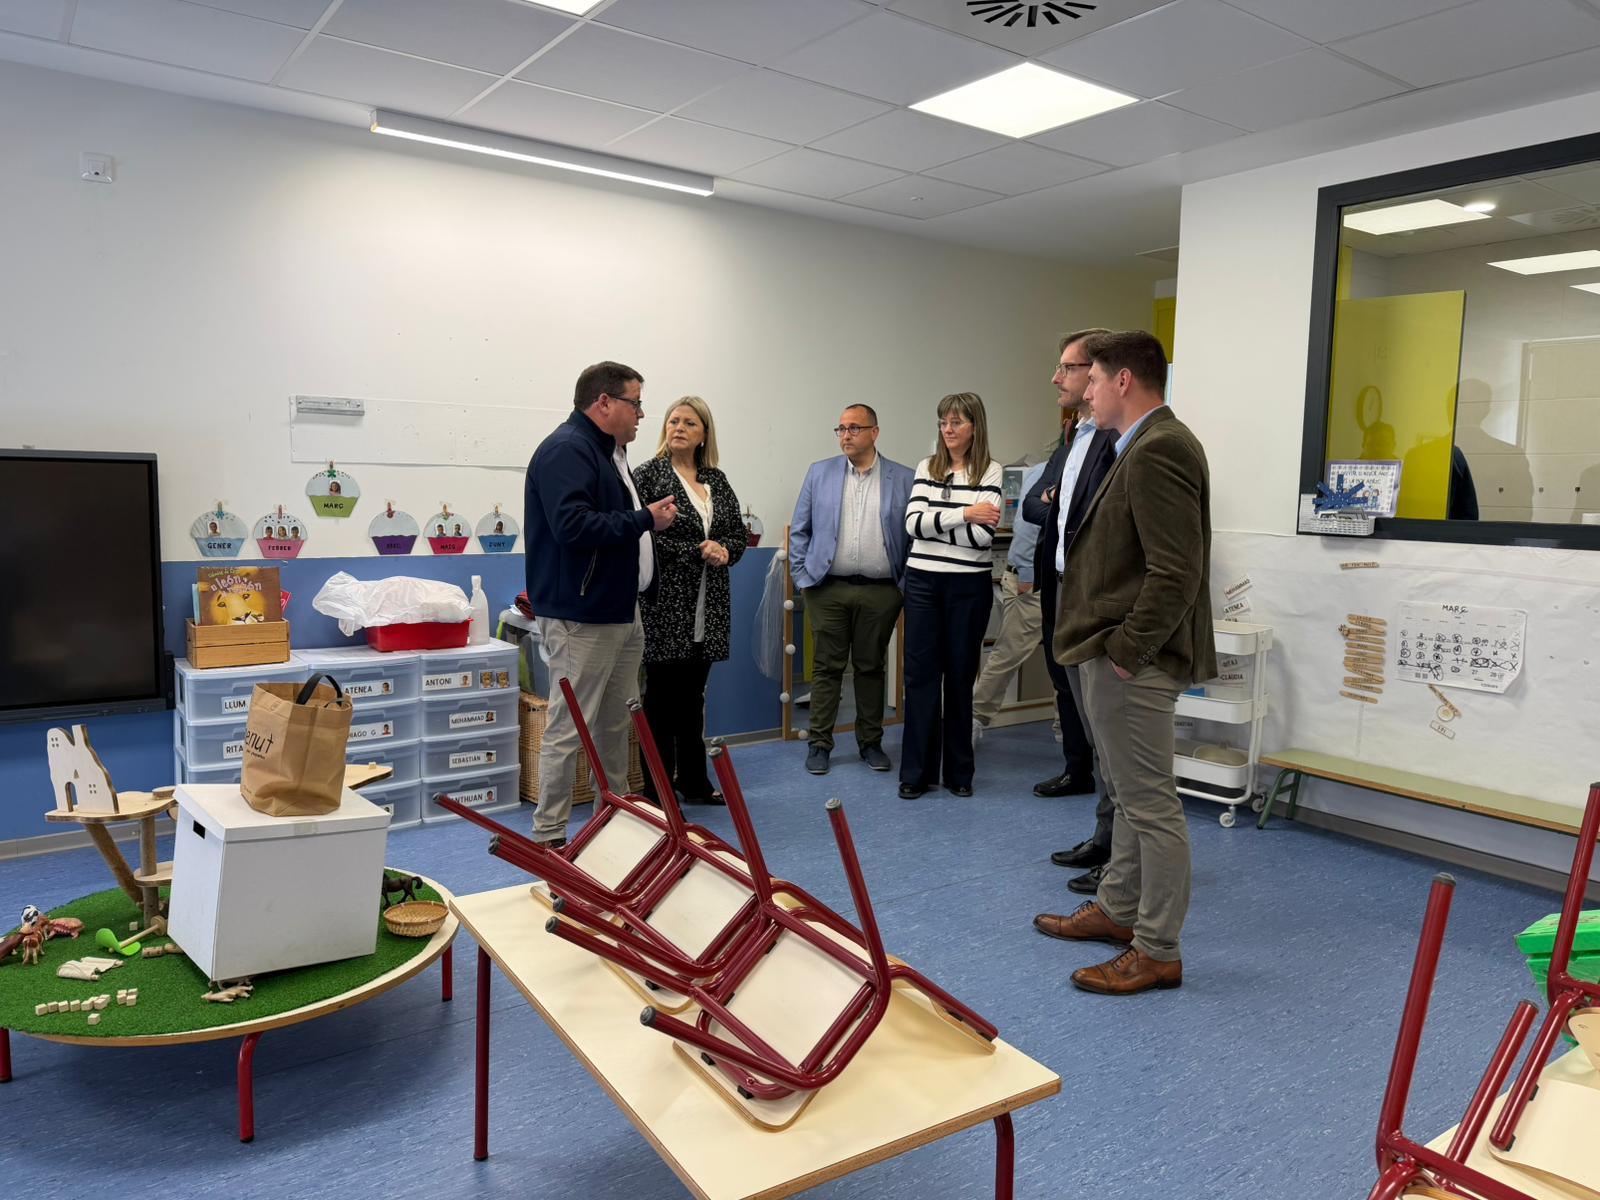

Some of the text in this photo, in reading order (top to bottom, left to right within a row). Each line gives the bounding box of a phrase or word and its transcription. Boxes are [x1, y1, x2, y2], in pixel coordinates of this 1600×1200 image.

[207, 542, 232, 550] GENER
[425, 677, 452, 686] ANTONI
[345, 685, 373, 694] ATENEA
[224, 700, 246, 710] LLUM
[452, 755, 481, 765] SEBASTIAN
